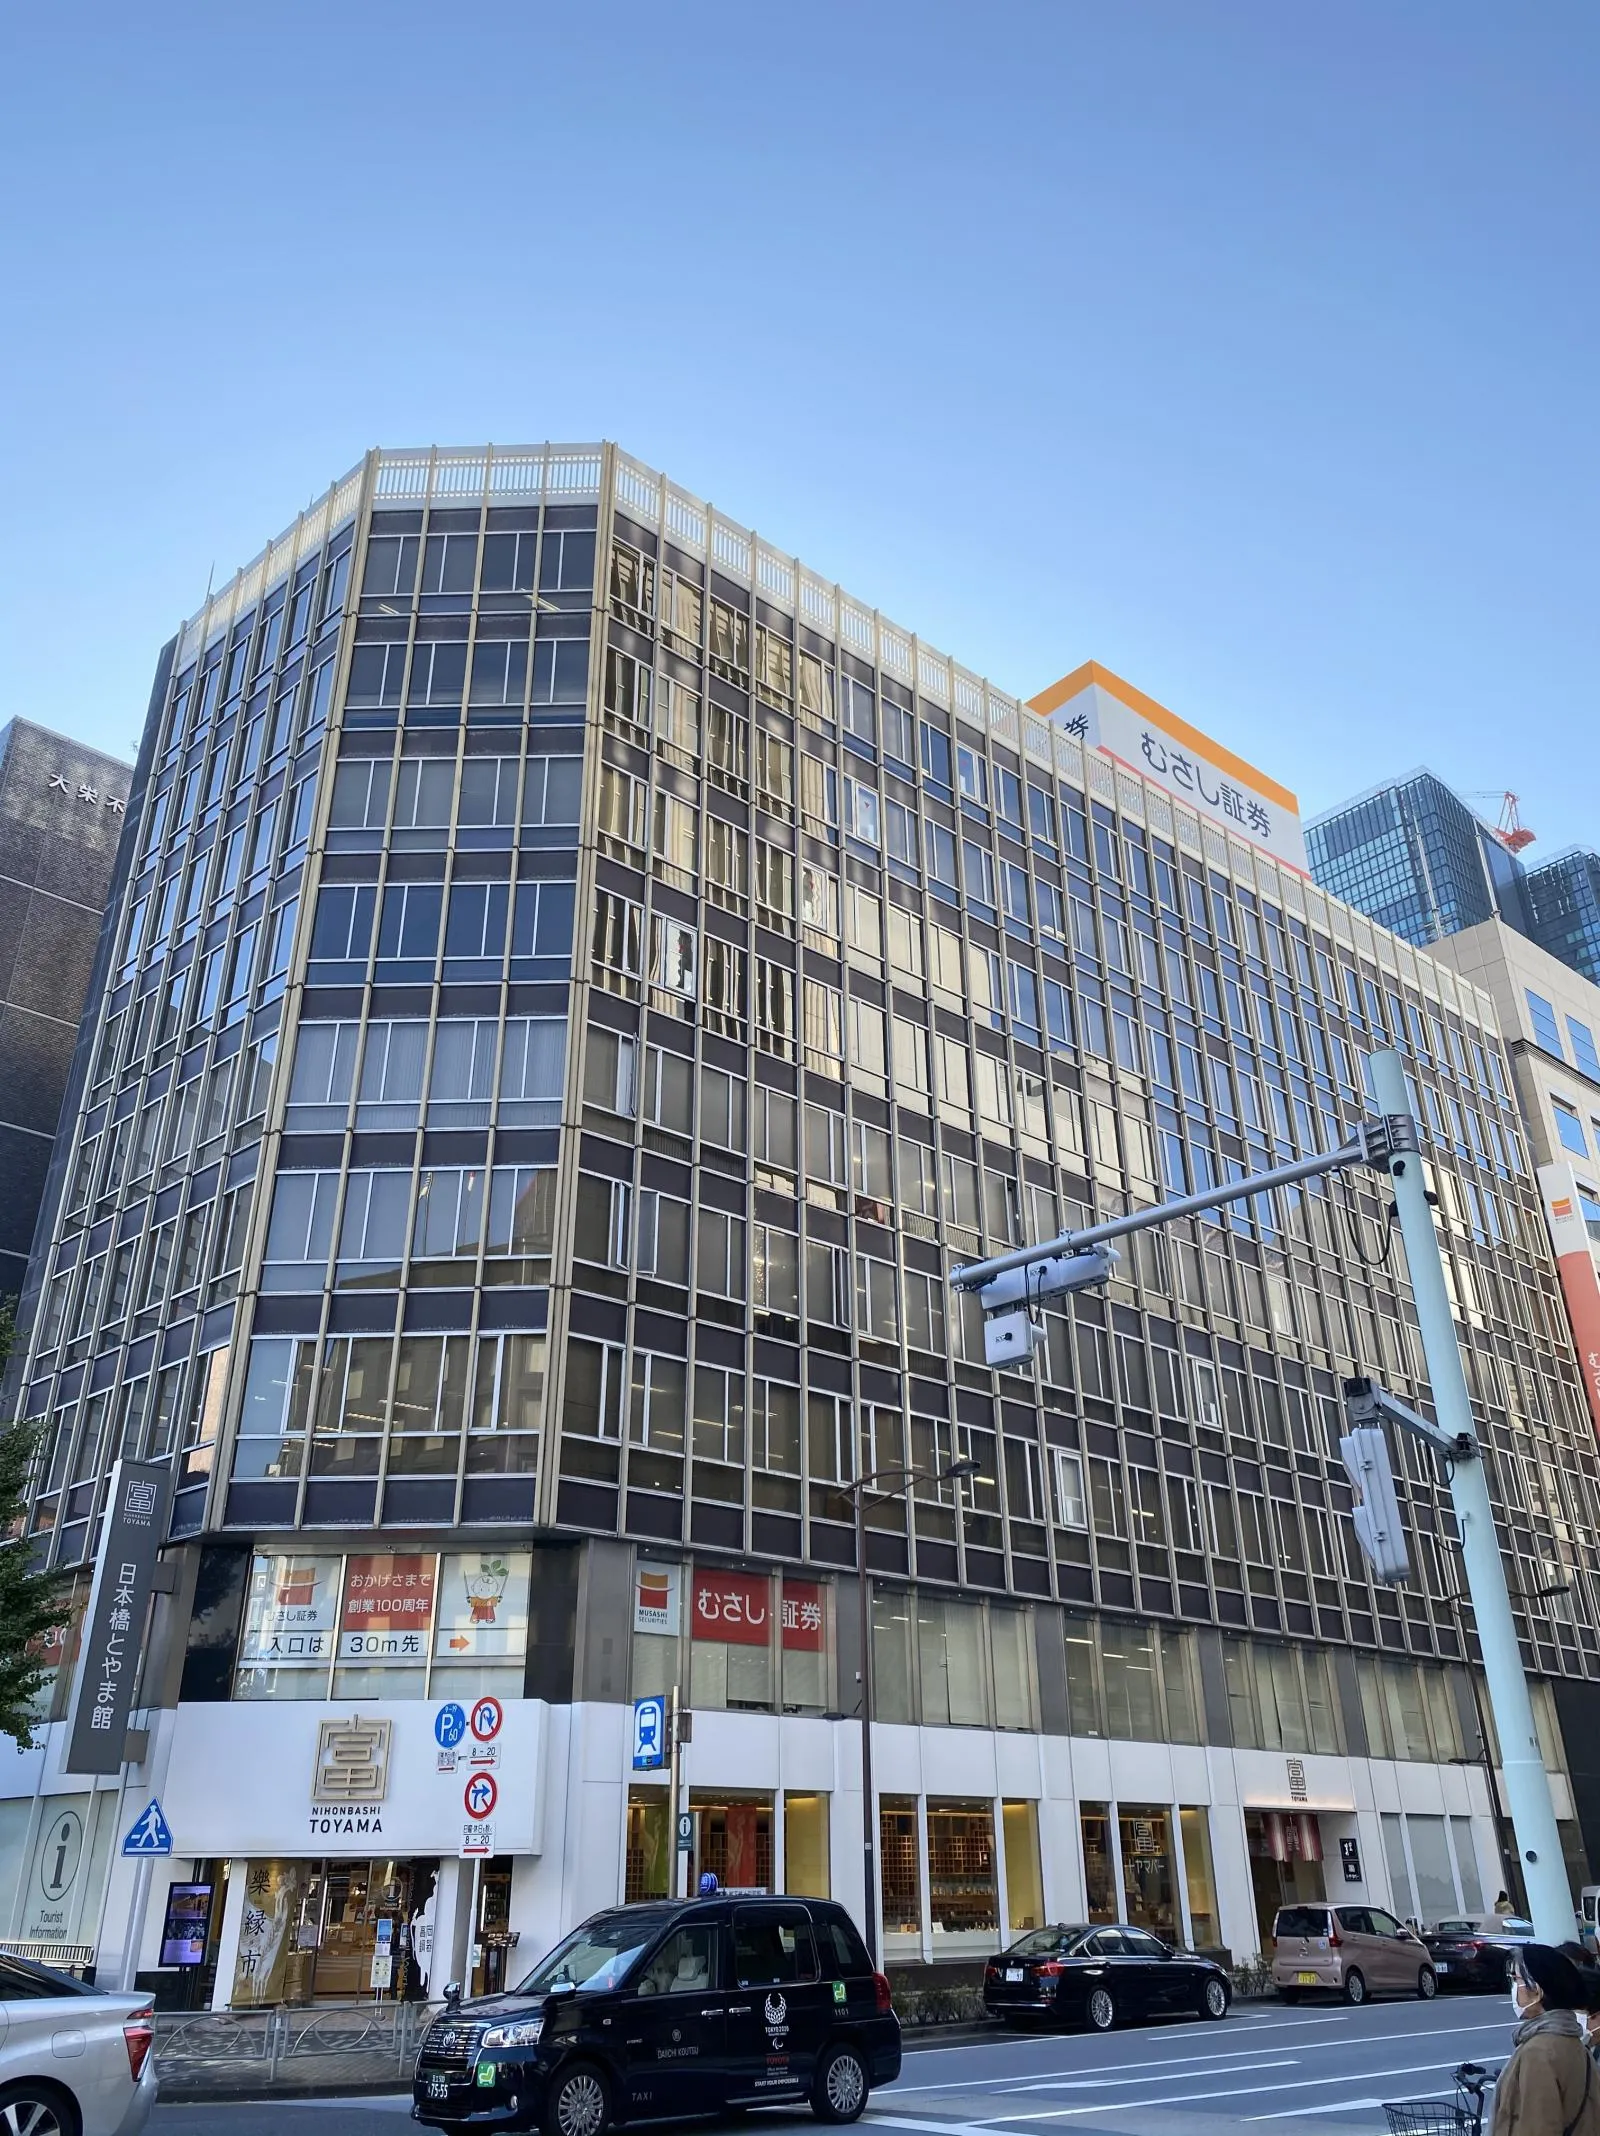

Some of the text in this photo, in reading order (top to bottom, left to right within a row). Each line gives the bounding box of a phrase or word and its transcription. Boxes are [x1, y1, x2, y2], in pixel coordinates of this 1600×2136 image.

[1140, 731, 1272, 838] むさし証券
[122, 1517, 151, 1527] TOYAMA
[350, 1573, 432, 1588] おかげさまで
[347, 1598, 429, 1614] 創業100周年
[638, 1608, 668, 1619] MUSASHI
[697, 1588, 822, 1632] むさし証券
[90, 1563, 137, 1730] 日本橋とやま館
[267, 1635, 420, 1654] 入口は 30m先
[440, 1713, 454, 1742] P
[311, 1806, 381, 1816] NIHONBASHI
[309, 1818, 383, 1834] TOYAMA
[39, 1910, 64, 1924] Tourist
[29, 1926, 68, 1939] Information
[834, 2008, 849, 2016] 1101
[631, 2091, 653, 2102] TAXI
